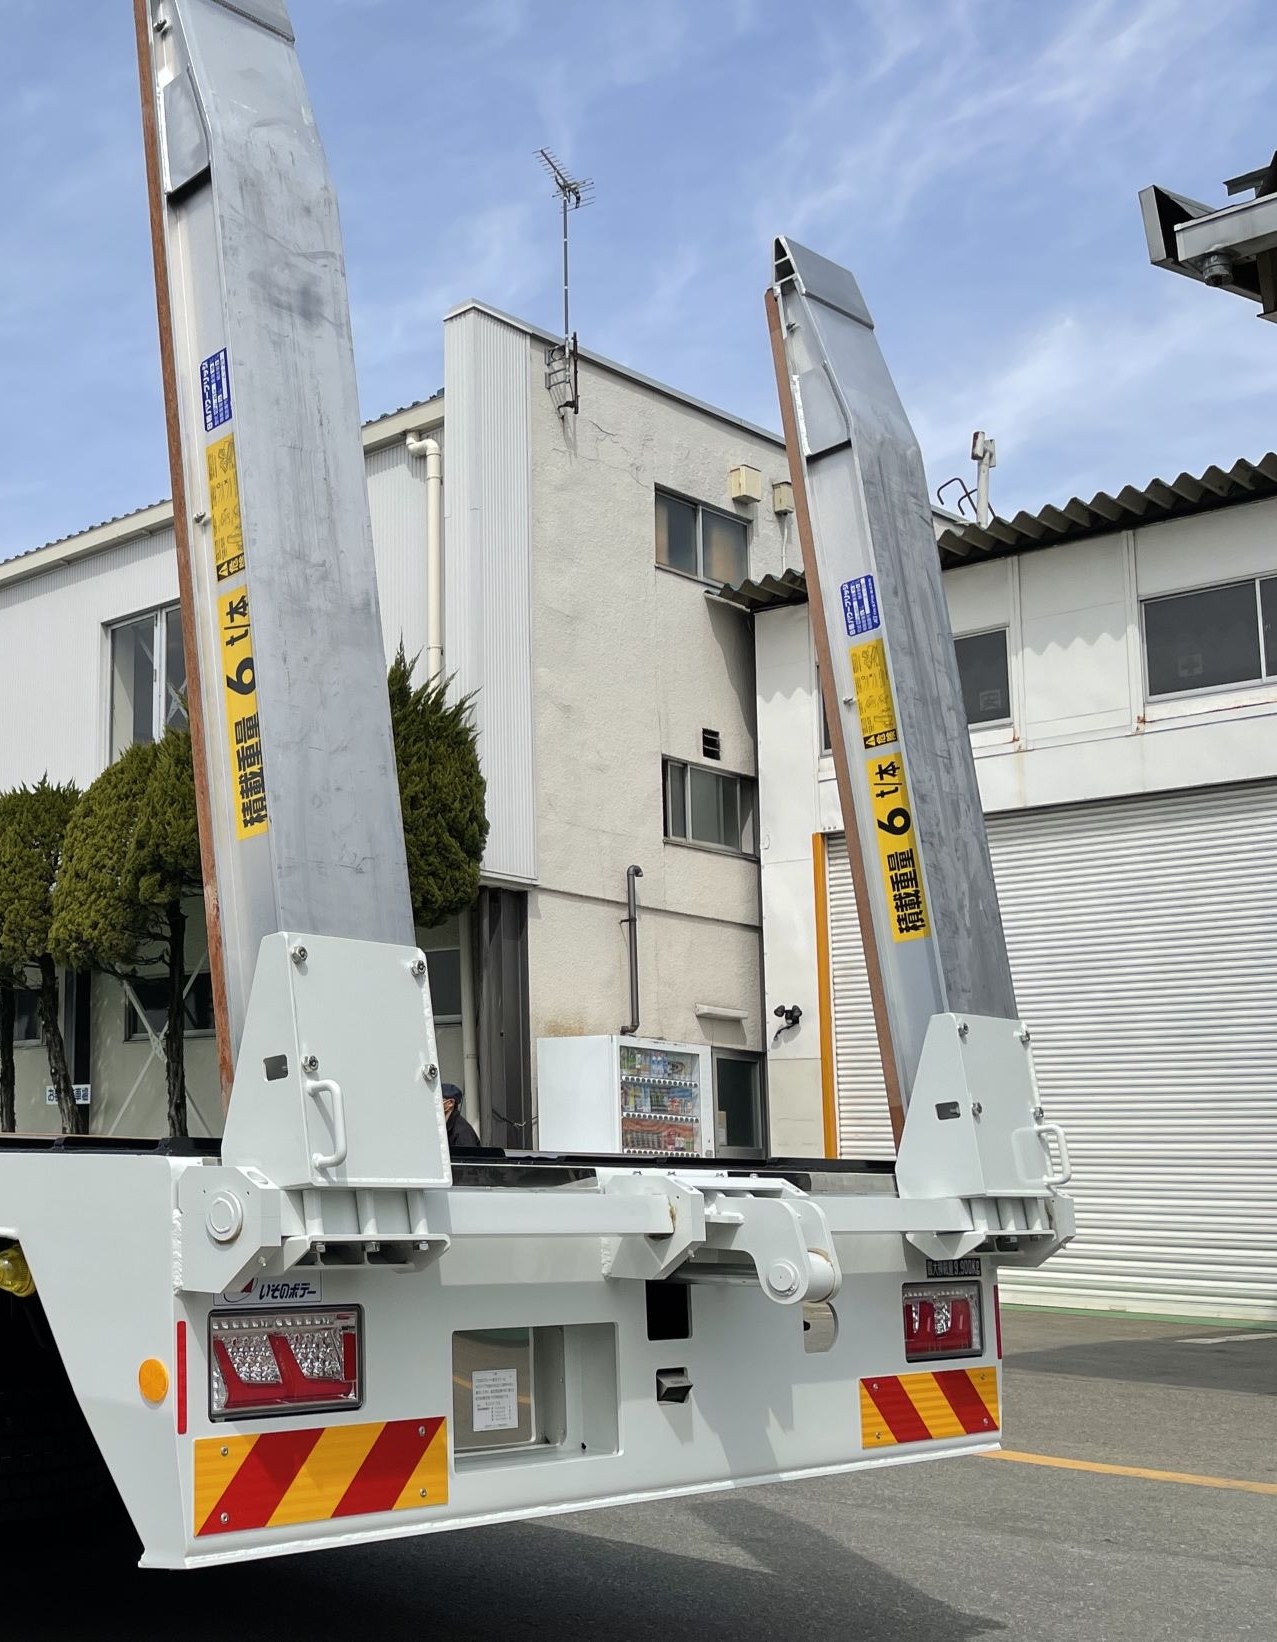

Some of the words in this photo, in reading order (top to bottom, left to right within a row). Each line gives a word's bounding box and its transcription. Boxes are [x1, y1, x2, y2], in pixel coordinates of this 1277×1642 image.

[225, 656, 256, 696] 6
[234, 711, 267, 828] 積載重量
[877, 807, 911, 836] 6
[887, 848, 926, 934] 積載重量
[258, 1282, 317, 1300] いそのボデー
